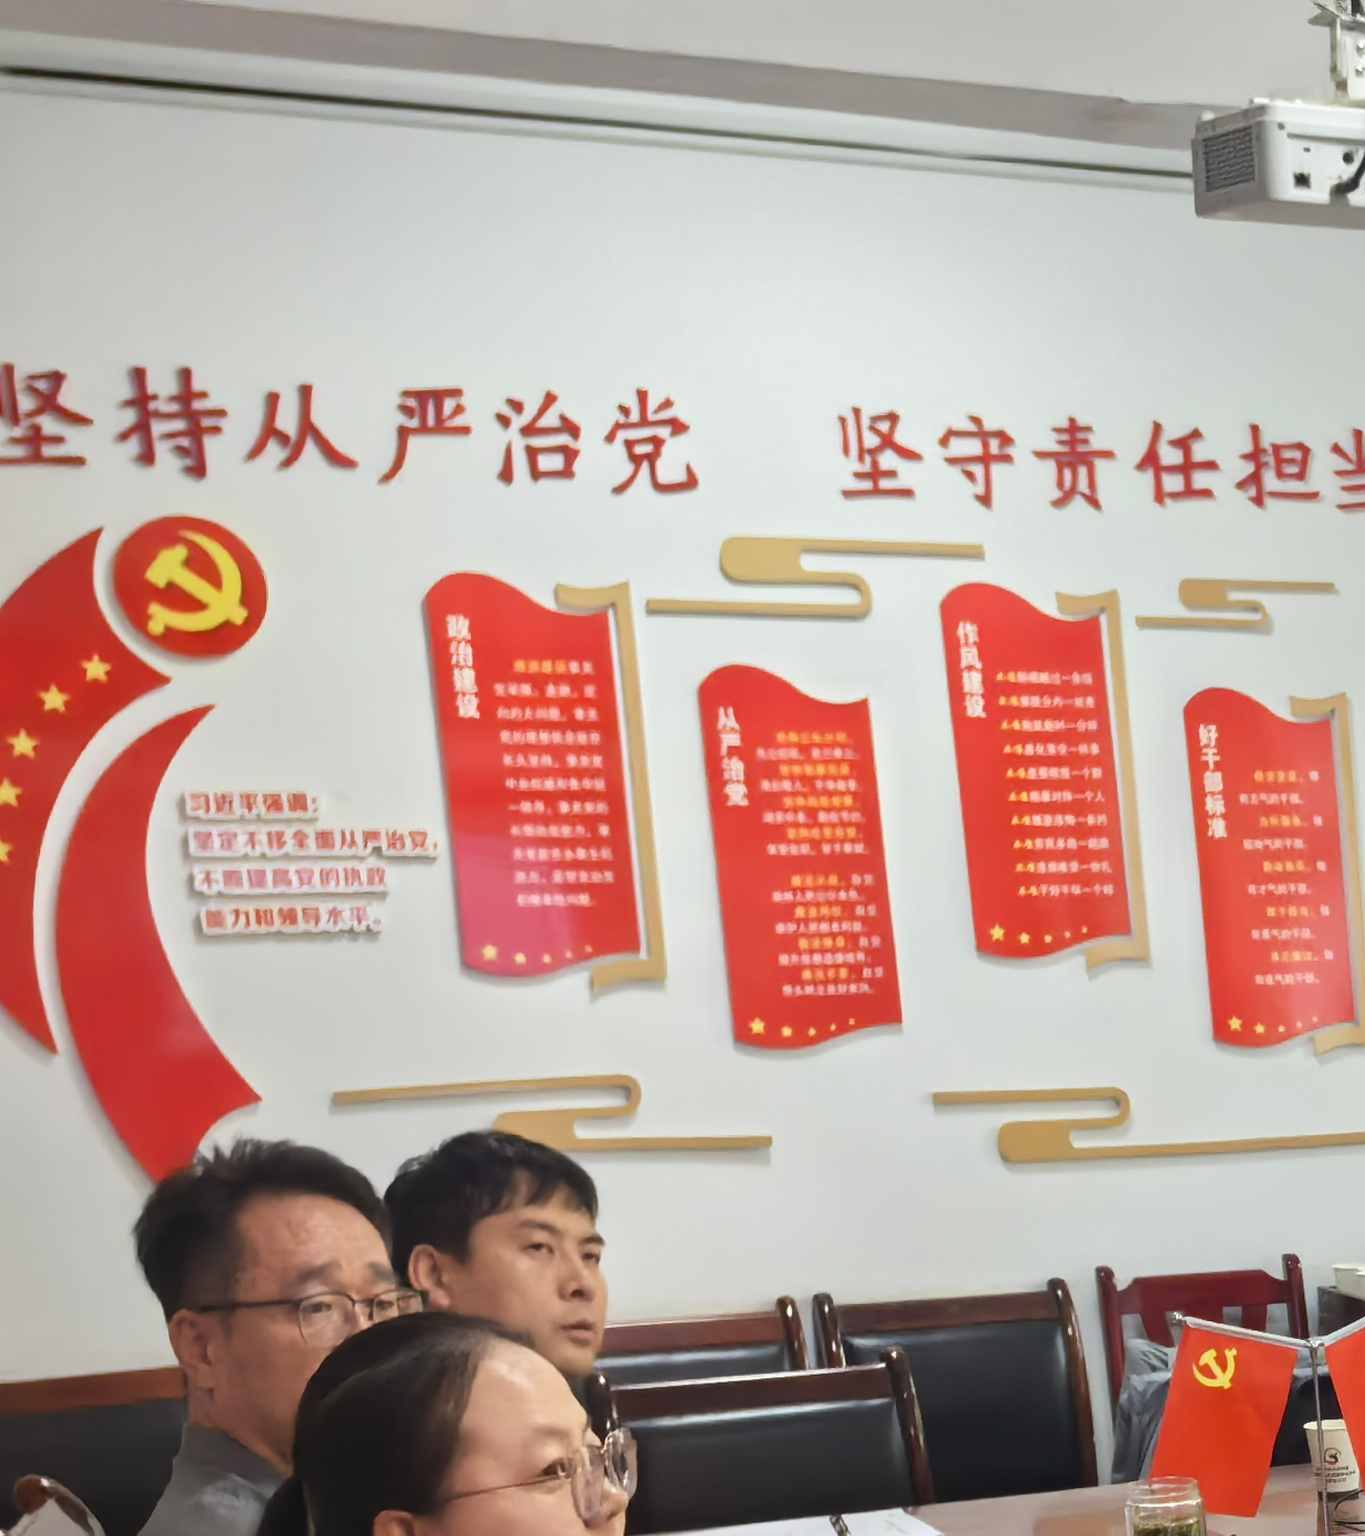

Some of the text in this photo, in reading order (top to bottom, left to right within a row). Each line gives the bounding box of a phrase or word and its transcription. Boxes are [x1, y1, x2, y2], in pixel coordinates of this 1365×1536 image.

[0, 363, 699, 495] 坚持从严治党
[446, 614, 480, 720] 政治建设
[956, 620, 987, 718] 作风建设
[717, 706, 749, 806] 从严治党
[1198, 724, 1228, 839] 好干部标准
